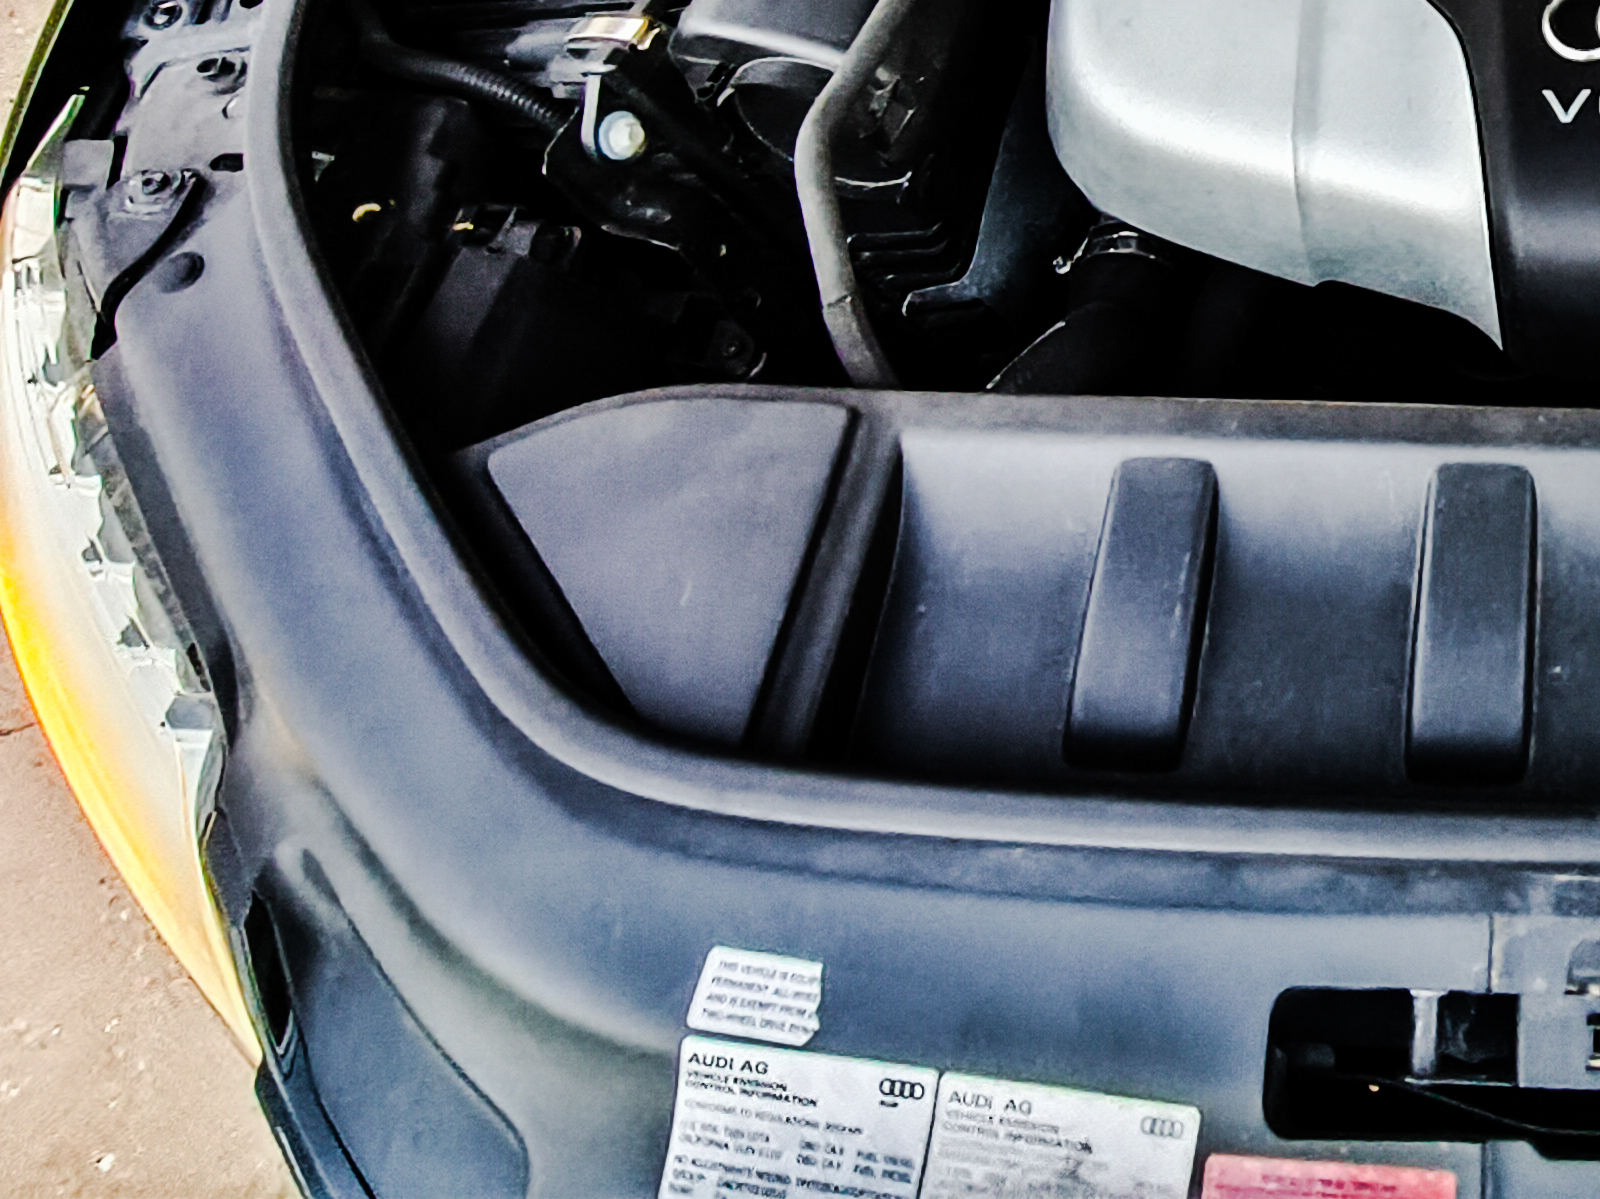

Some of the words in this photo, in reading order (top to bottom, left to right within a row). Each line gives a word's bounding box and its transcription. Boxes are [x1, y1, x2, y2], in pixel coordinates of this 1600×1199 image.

[687, 1052, 734, 1070] AUDI
[740, 1060, 769, 1075] AG
[684, 1080, 736, 1096] CONTROL
[739, 1087, 817, 1107] INFORMATION
[949, 1090, 993, 1109] AUDI
[1003, 1099, 1033, 1116] AG
